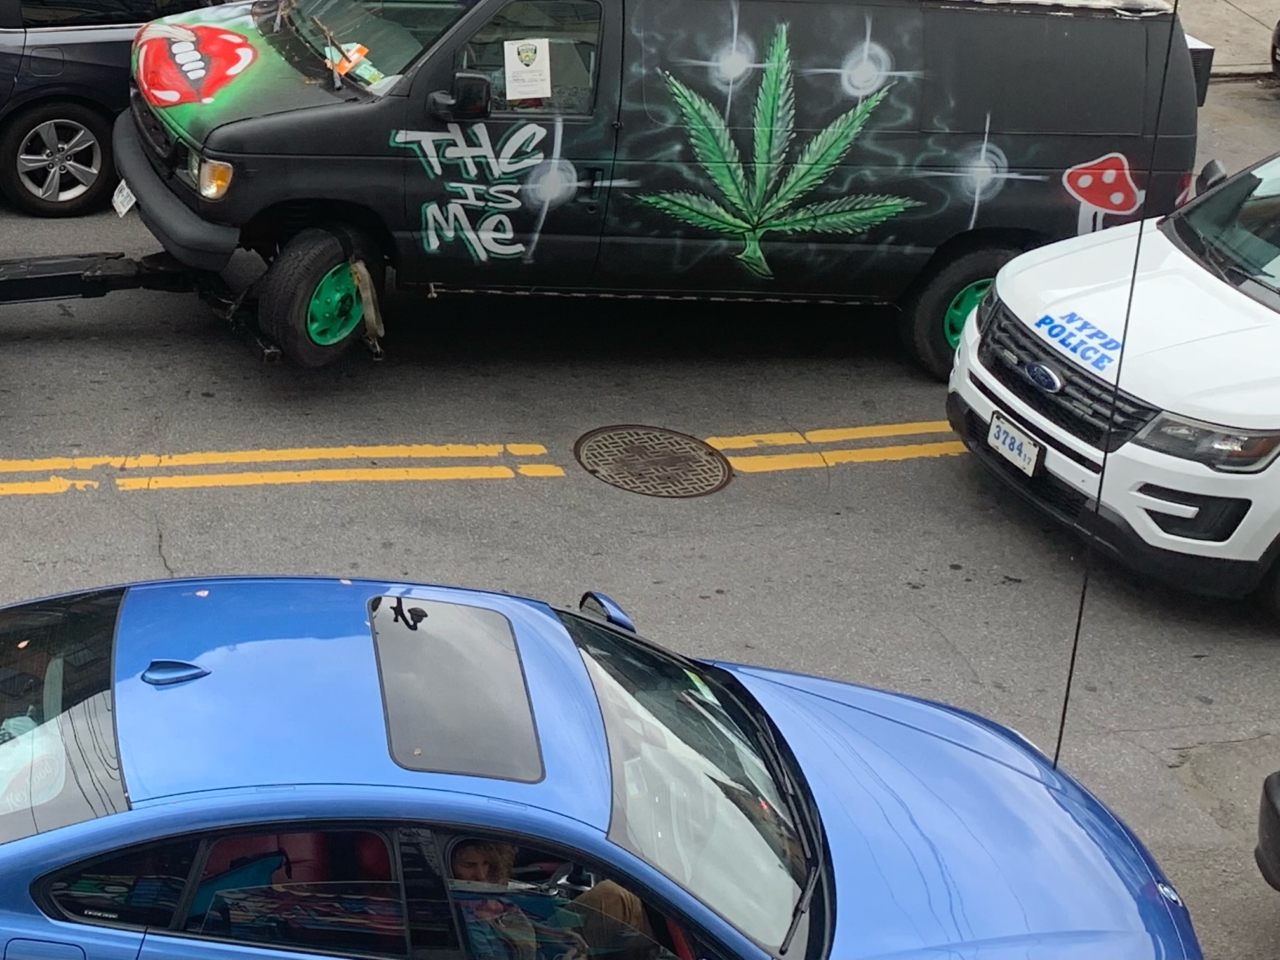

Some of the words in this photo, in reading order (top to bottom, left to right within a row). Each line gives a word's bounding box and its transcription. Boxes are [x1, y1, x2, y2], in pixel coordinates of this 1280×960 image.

[391, 121, 548, 180] THC
[447, 183, 522, 209] IS
[1034, 314, 1115, 372] POLICE
[1060, 311, 1122, 352] NYPD
